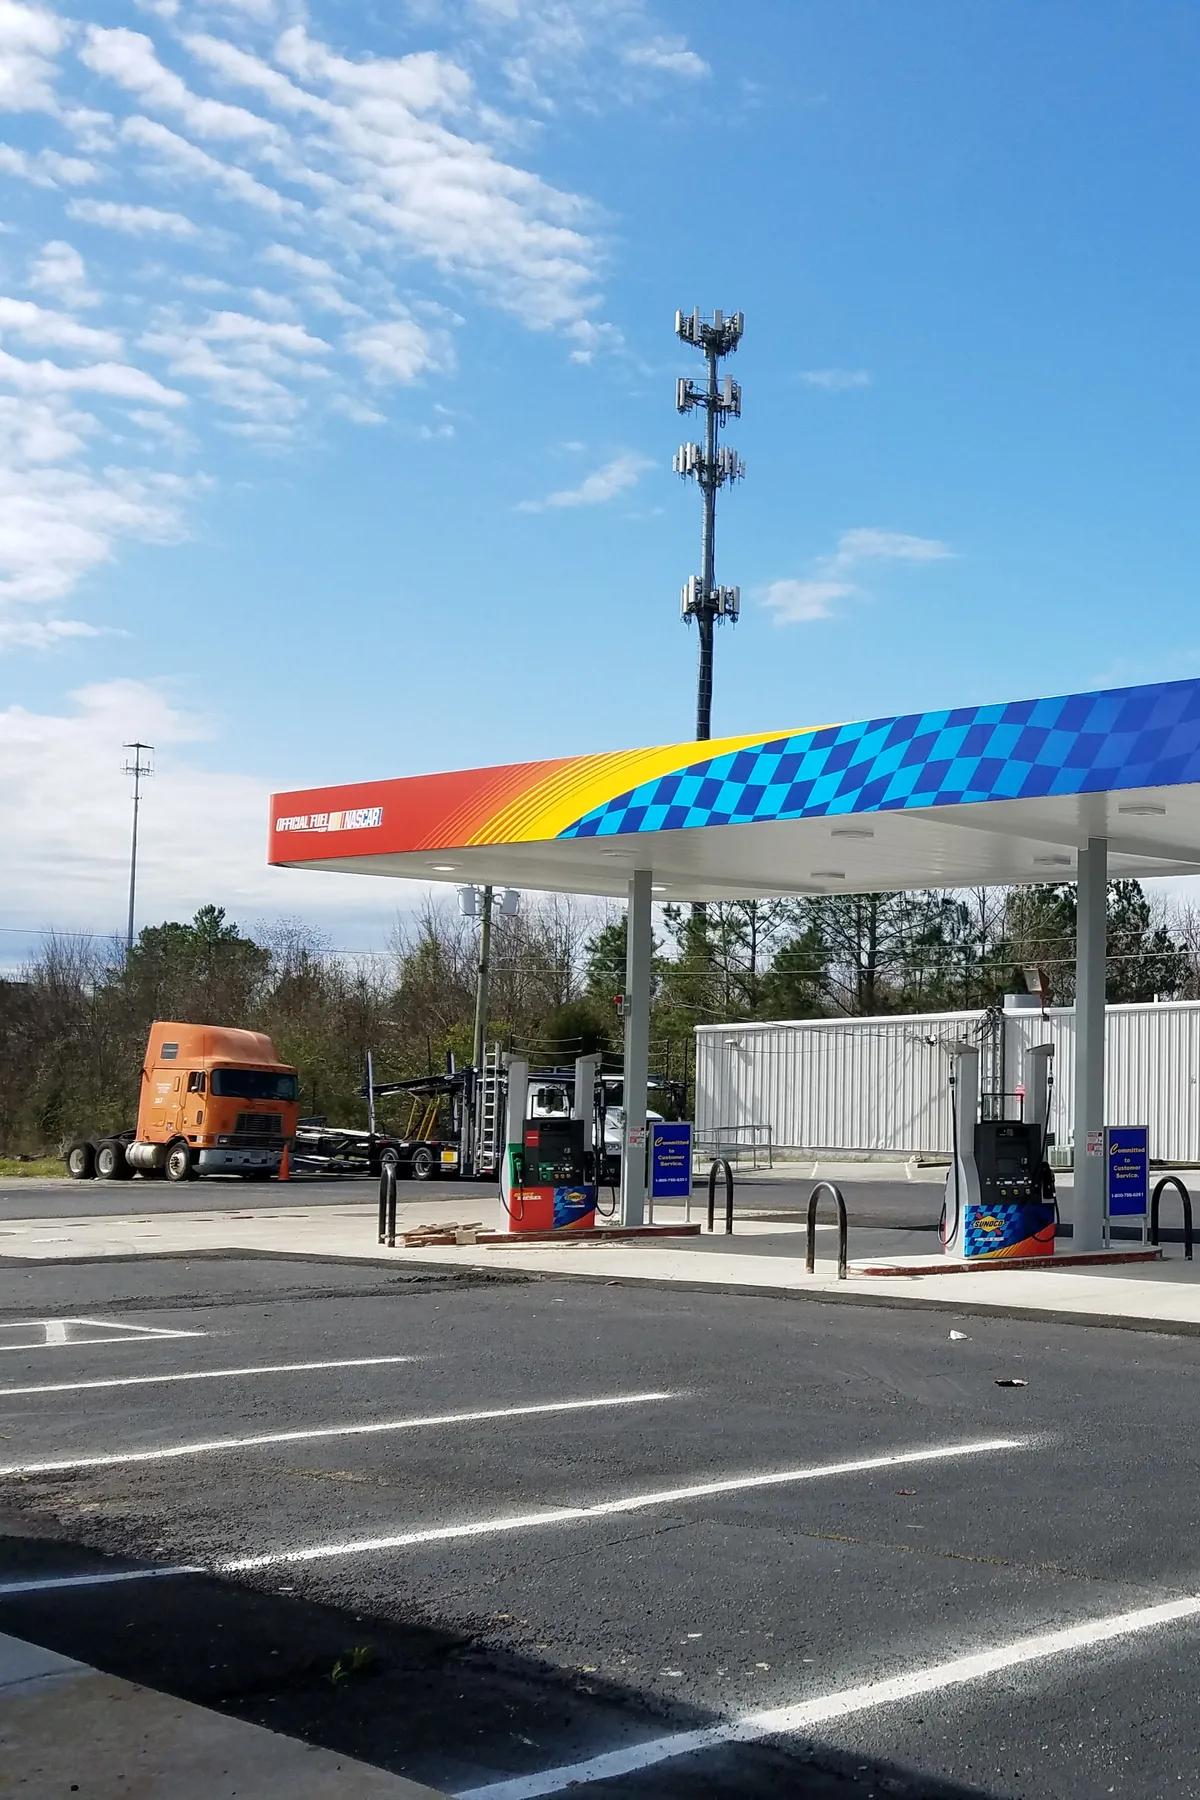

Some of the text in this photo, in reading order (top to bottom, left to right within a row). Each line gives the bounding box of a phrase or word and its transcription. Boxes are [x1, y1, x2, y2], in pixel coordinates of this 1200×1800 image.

[276, 815, 308, 832] OFFICIAL
[310, 813, 328, 828] FUEL
[344, 807, 382, 829] NASCAR
[655, 1136, 689, 1147] Committed
[1110, 1143, 1145, 1155] Committed
[974, 1220, 1004, 1228] SUNOCO
